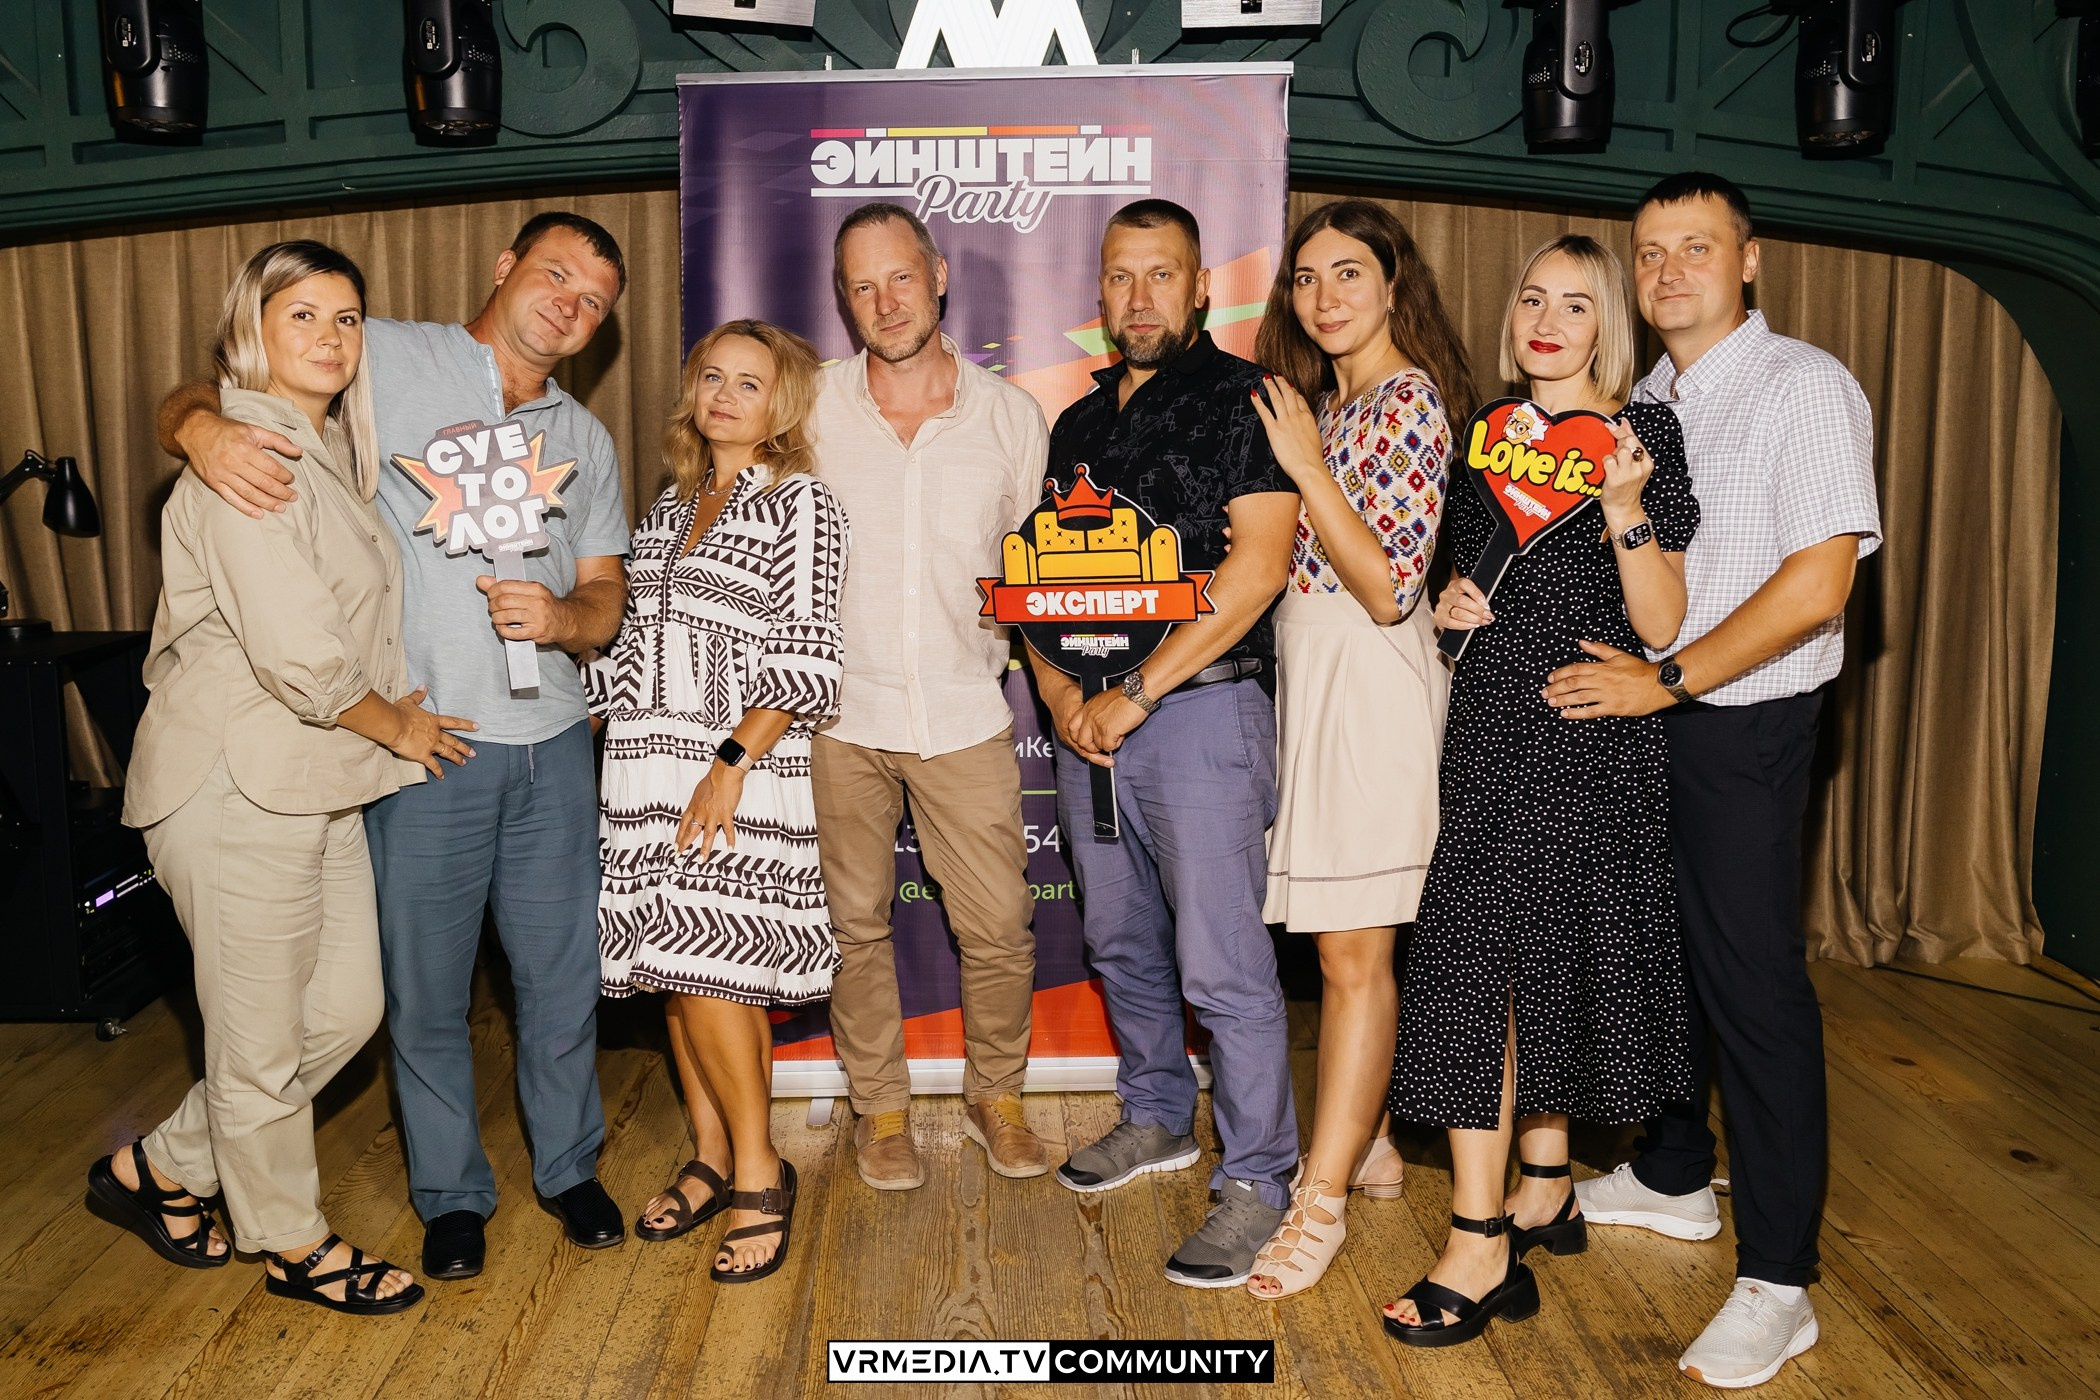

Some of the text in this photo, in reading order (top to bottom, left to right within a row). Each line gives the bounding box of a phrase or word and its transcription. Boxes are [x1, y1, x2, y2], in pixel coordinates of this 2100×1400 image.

[810, 126, 1152, 184] ЭЙНШТЕЙН
[914, 173, 1053, 234] Party
[426, 423, 529, 475] СУЕ
[1468, 420, 1556, 485] Love
[457, 465, 528, 507] ТО
[449, 497, 545, 551] ЛОГ
[1026, 589, 1159, 616] ЭКСПЕРТ
[1081, 644, 1110, 658] Party
[1028, 880, 1078, 901] part
